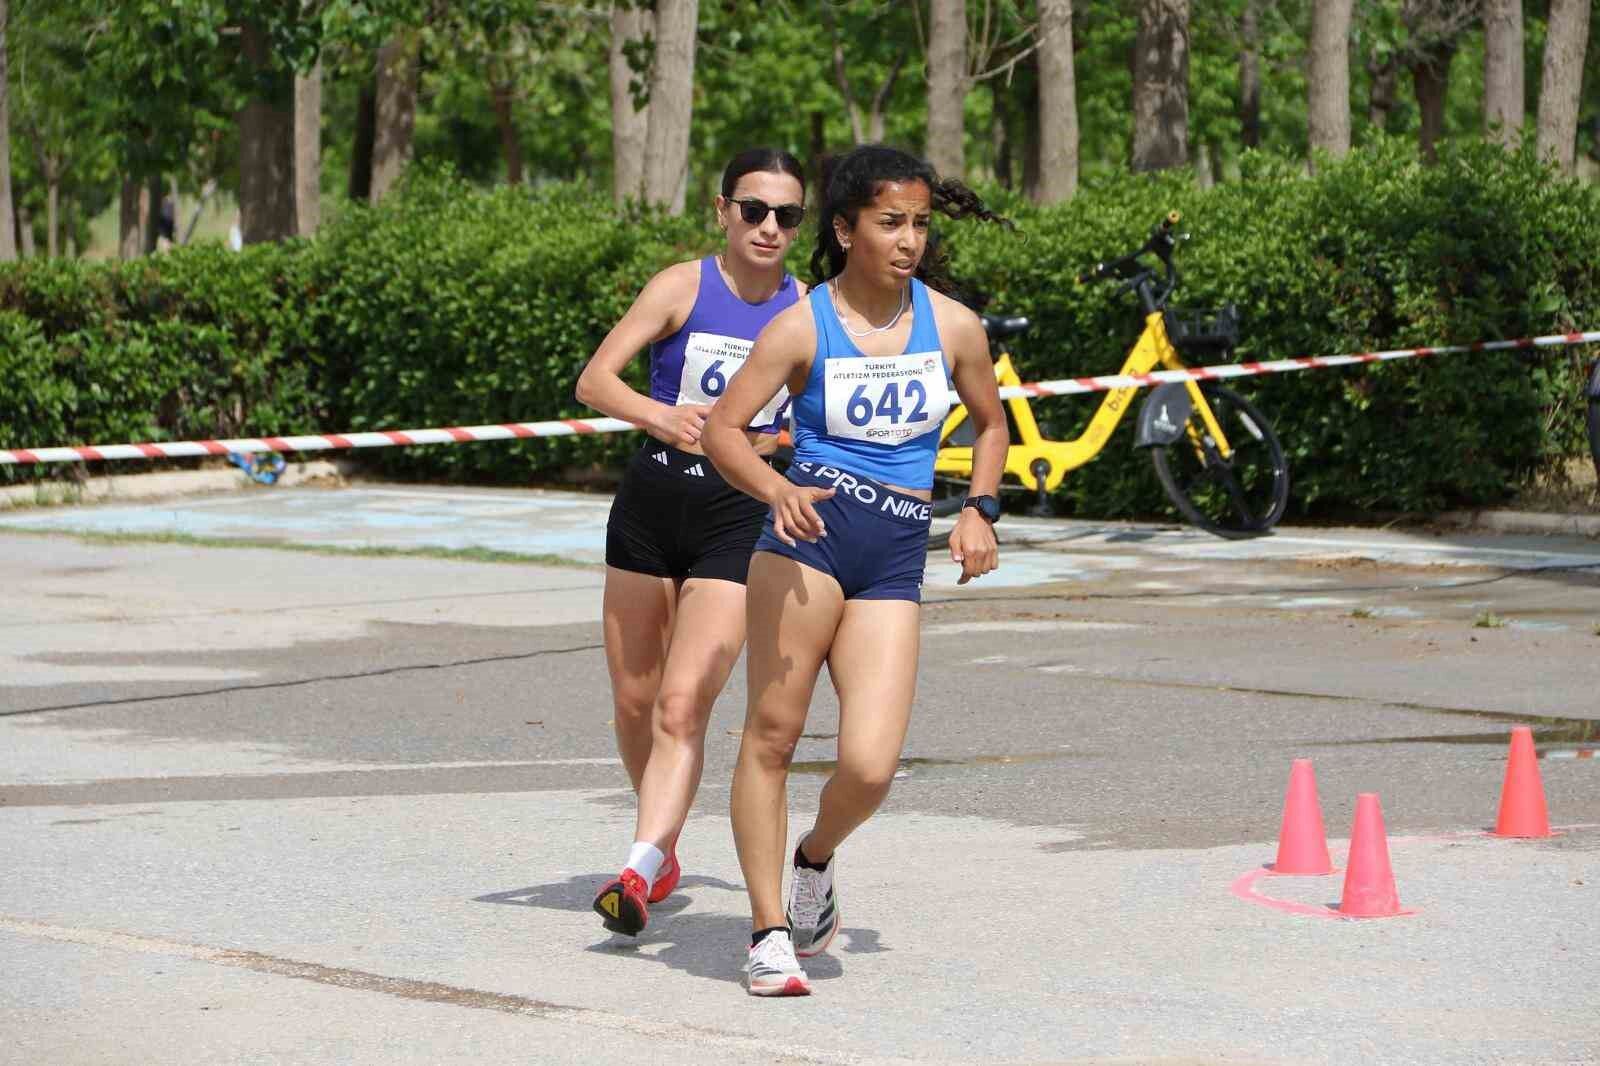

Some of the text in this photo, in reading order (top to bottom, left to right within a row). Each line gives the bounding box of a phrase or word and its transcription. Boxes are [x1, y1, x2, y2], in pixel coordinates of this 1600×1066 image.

[846, 379, 929, 427] 642
[814, 465, 877, 504] PRO
[880, 495, 931, 520] NIKE
